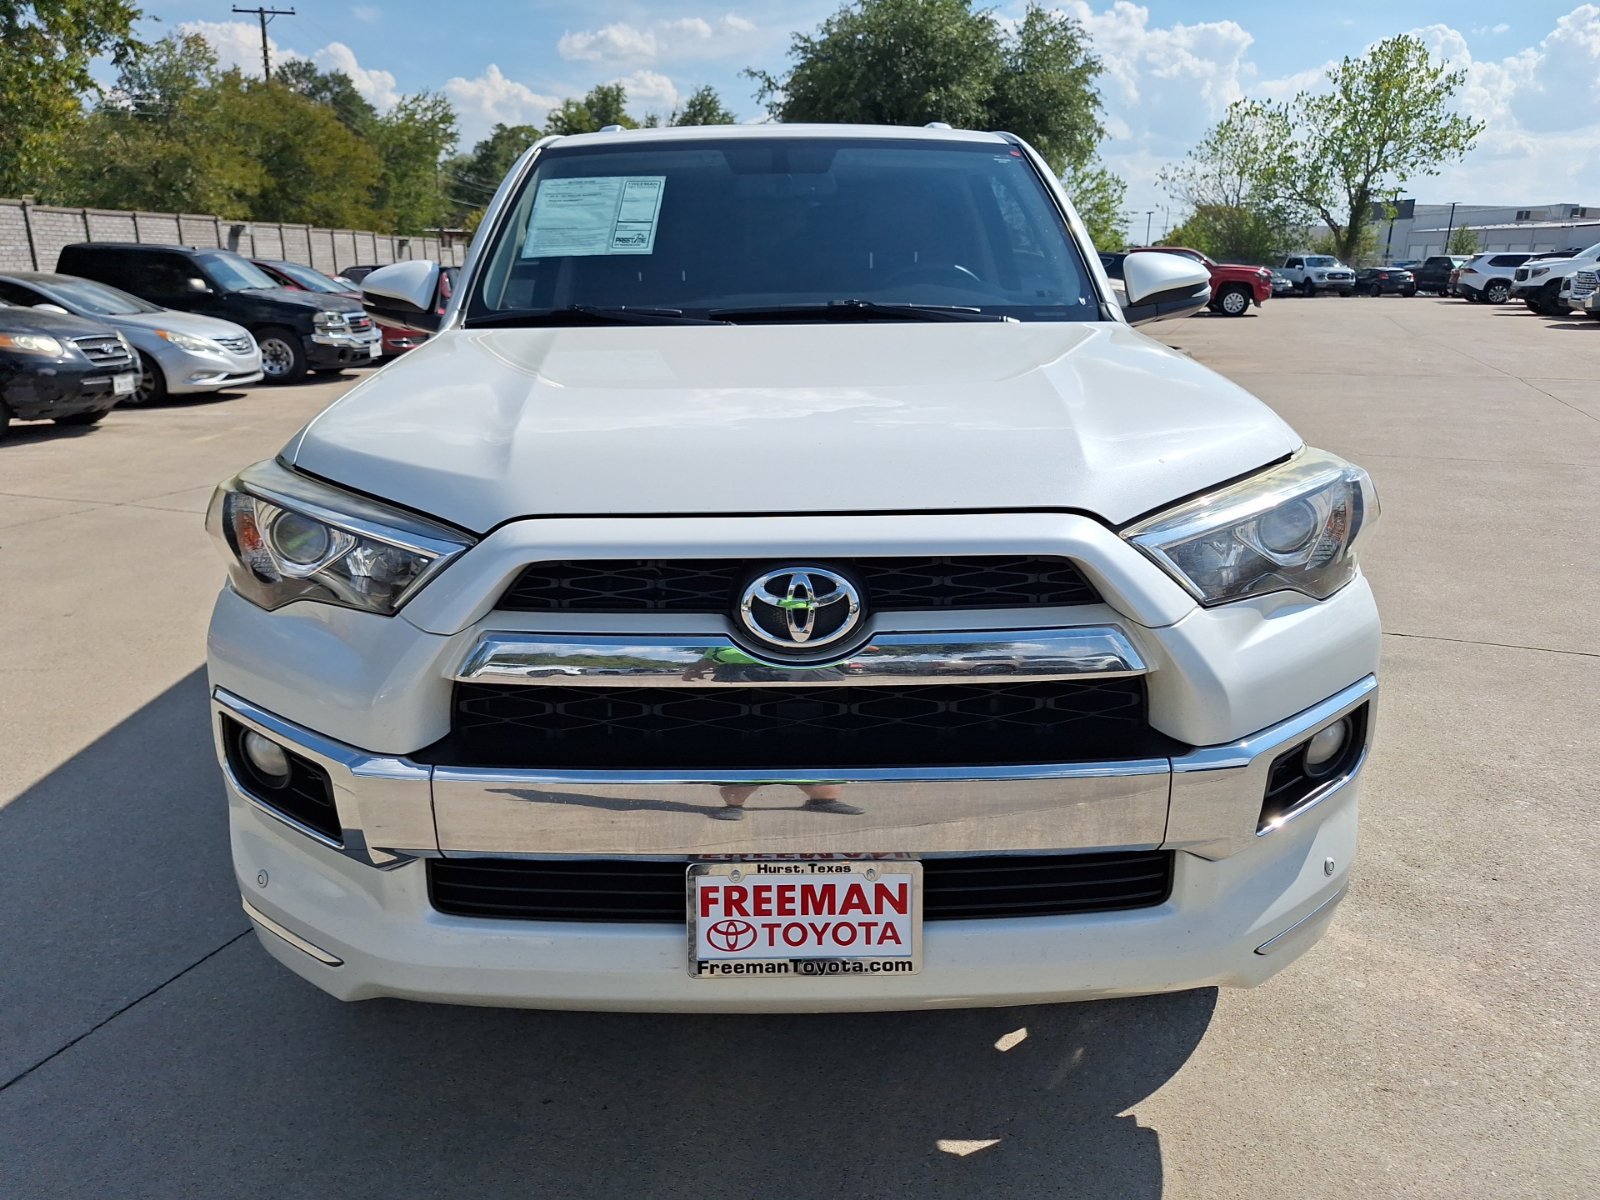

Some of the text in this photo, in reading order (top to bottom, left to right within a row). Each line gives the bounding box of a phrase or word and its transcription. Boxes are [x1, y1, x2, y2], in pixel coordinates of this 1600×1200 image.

[757, 863, 852, 874] Hurst, Texas
[700, 883, 908, 917] FREEMAN
[761, 921, 902, 946] TOYOTA
[697, 959, 913, 976] FreemanToyota.com
